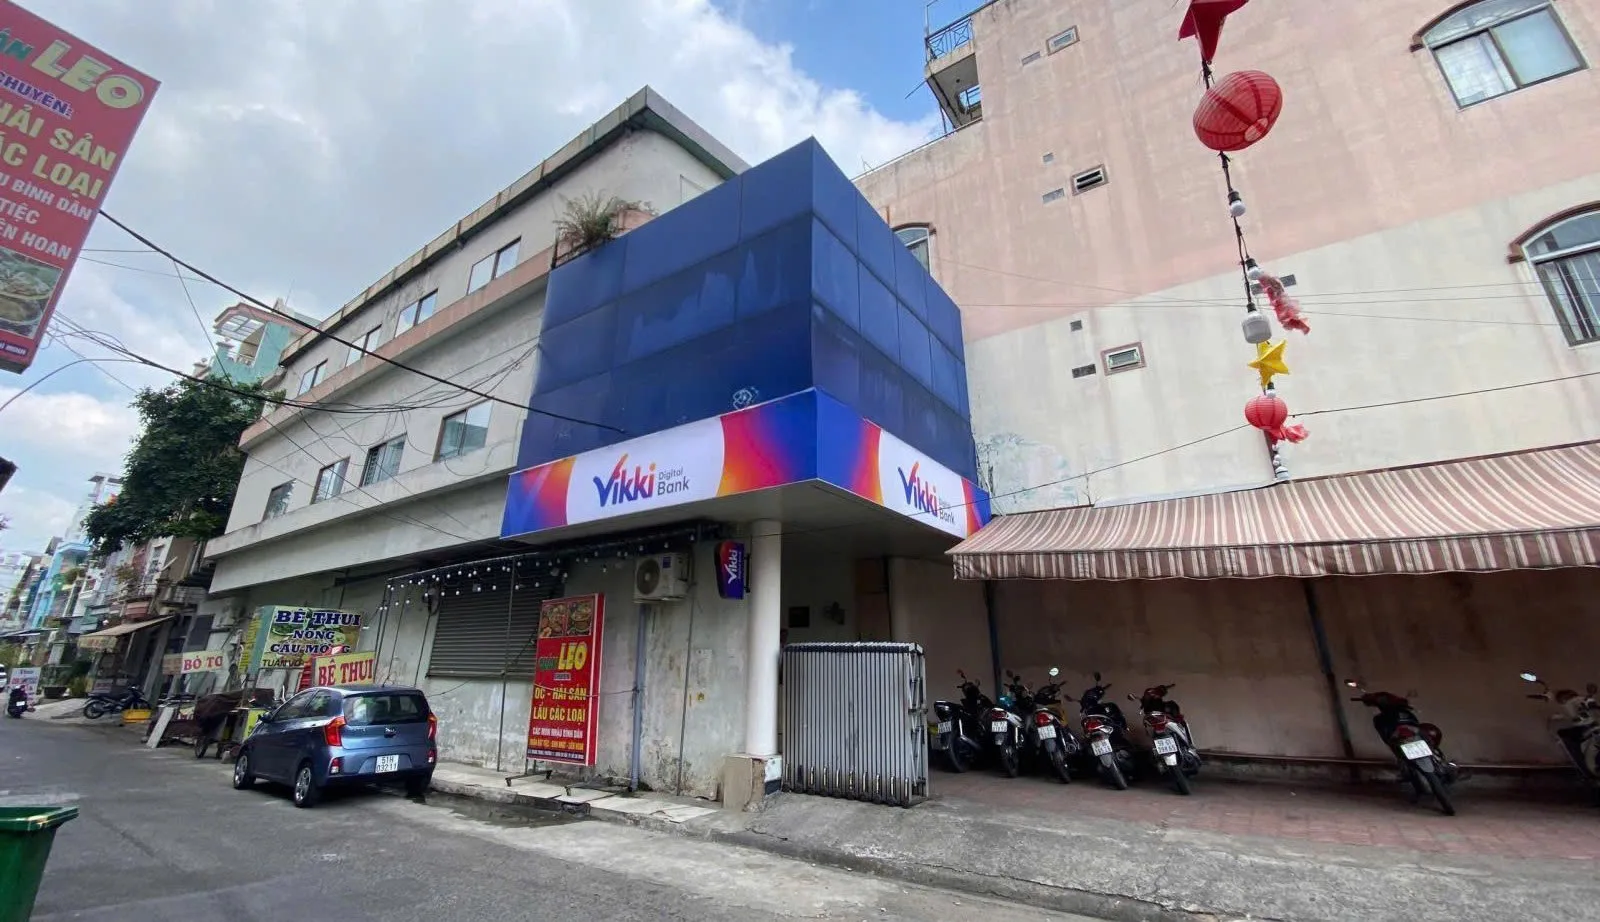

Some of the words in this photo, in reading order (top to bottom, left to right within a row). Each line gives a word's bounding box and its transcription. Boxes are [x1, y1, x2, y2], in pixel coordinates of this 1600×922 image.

[31, 39, 145, 109] LEO
[50, 128, 117, 171] SẢN
[32, 154, 104, 200] LOẠI
[21, 231, 72, 261] HOAN
[593, 453, 656, 507] Vikki
[659, 466, 683, 480] Digital
[657, 476, 690, 496] Bank
[897, 461, 938, 518] Vikki
[724, 548, 738, 584] Vikki
[313, 612, 361, 625] THUI
[318, 658, 336, 685] BÊ
[341, 659, 375, 682] THUI
[558, 642, 588, 670] LEO
[567, 708, 585, 726] LOẠI
